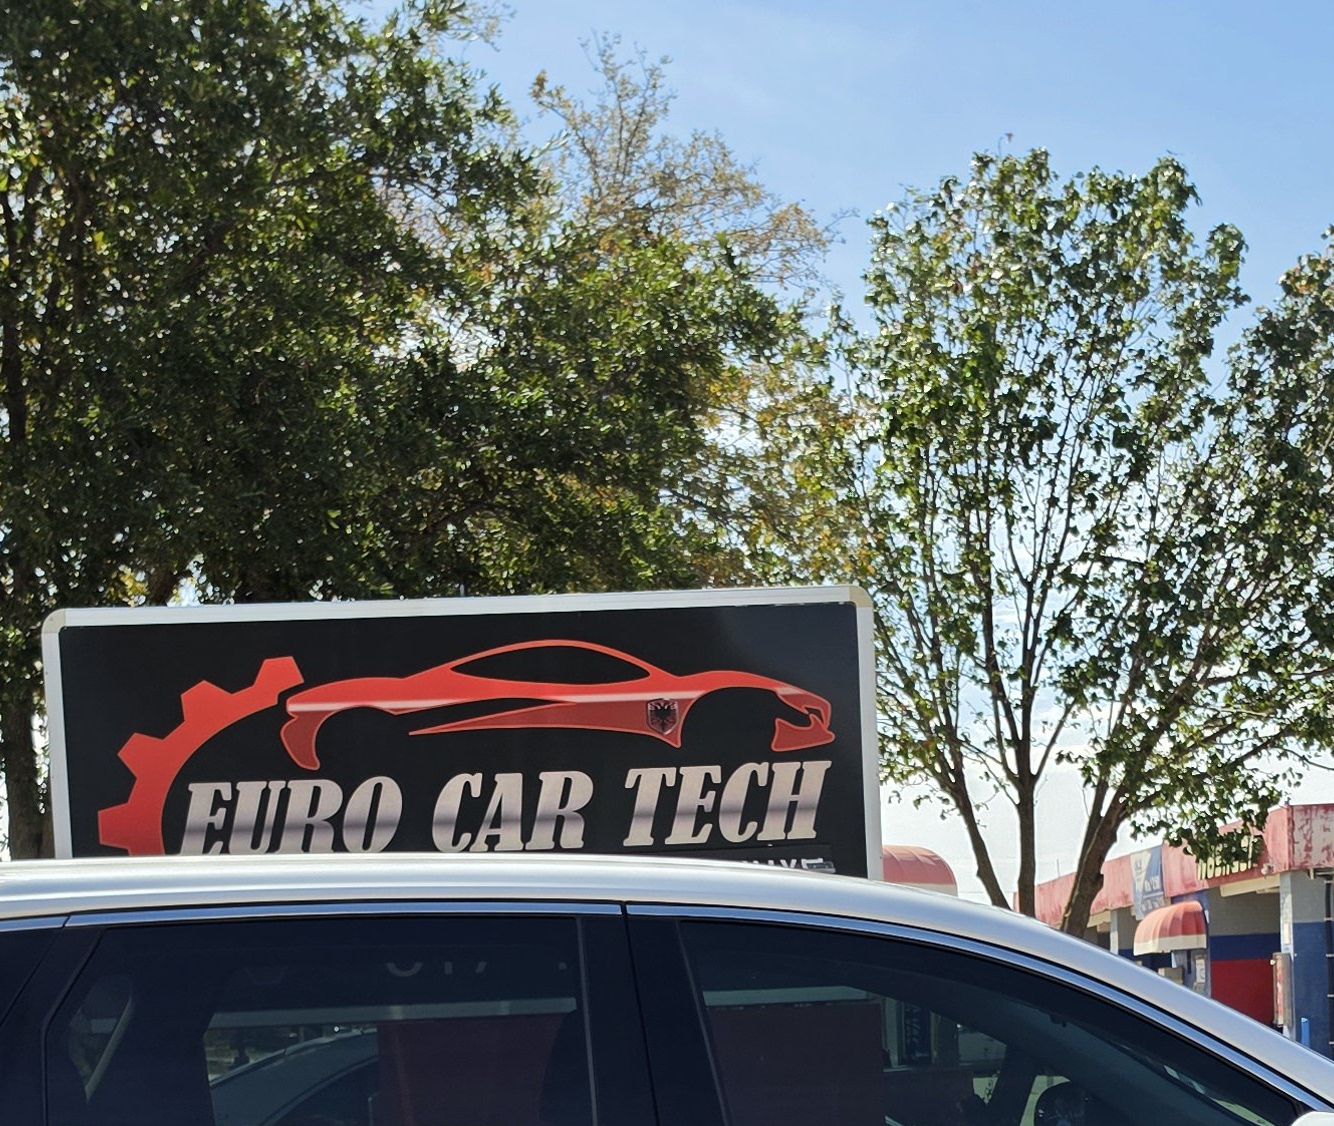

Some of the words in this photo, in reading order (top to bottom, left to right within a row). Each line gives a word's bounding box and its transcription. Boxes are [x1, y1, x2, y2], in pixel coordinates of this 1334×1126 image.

[179, 775, 403, 856] EURO
[431, 771, 594, 854] CAR
[624, 761, 832, 849] TECH
